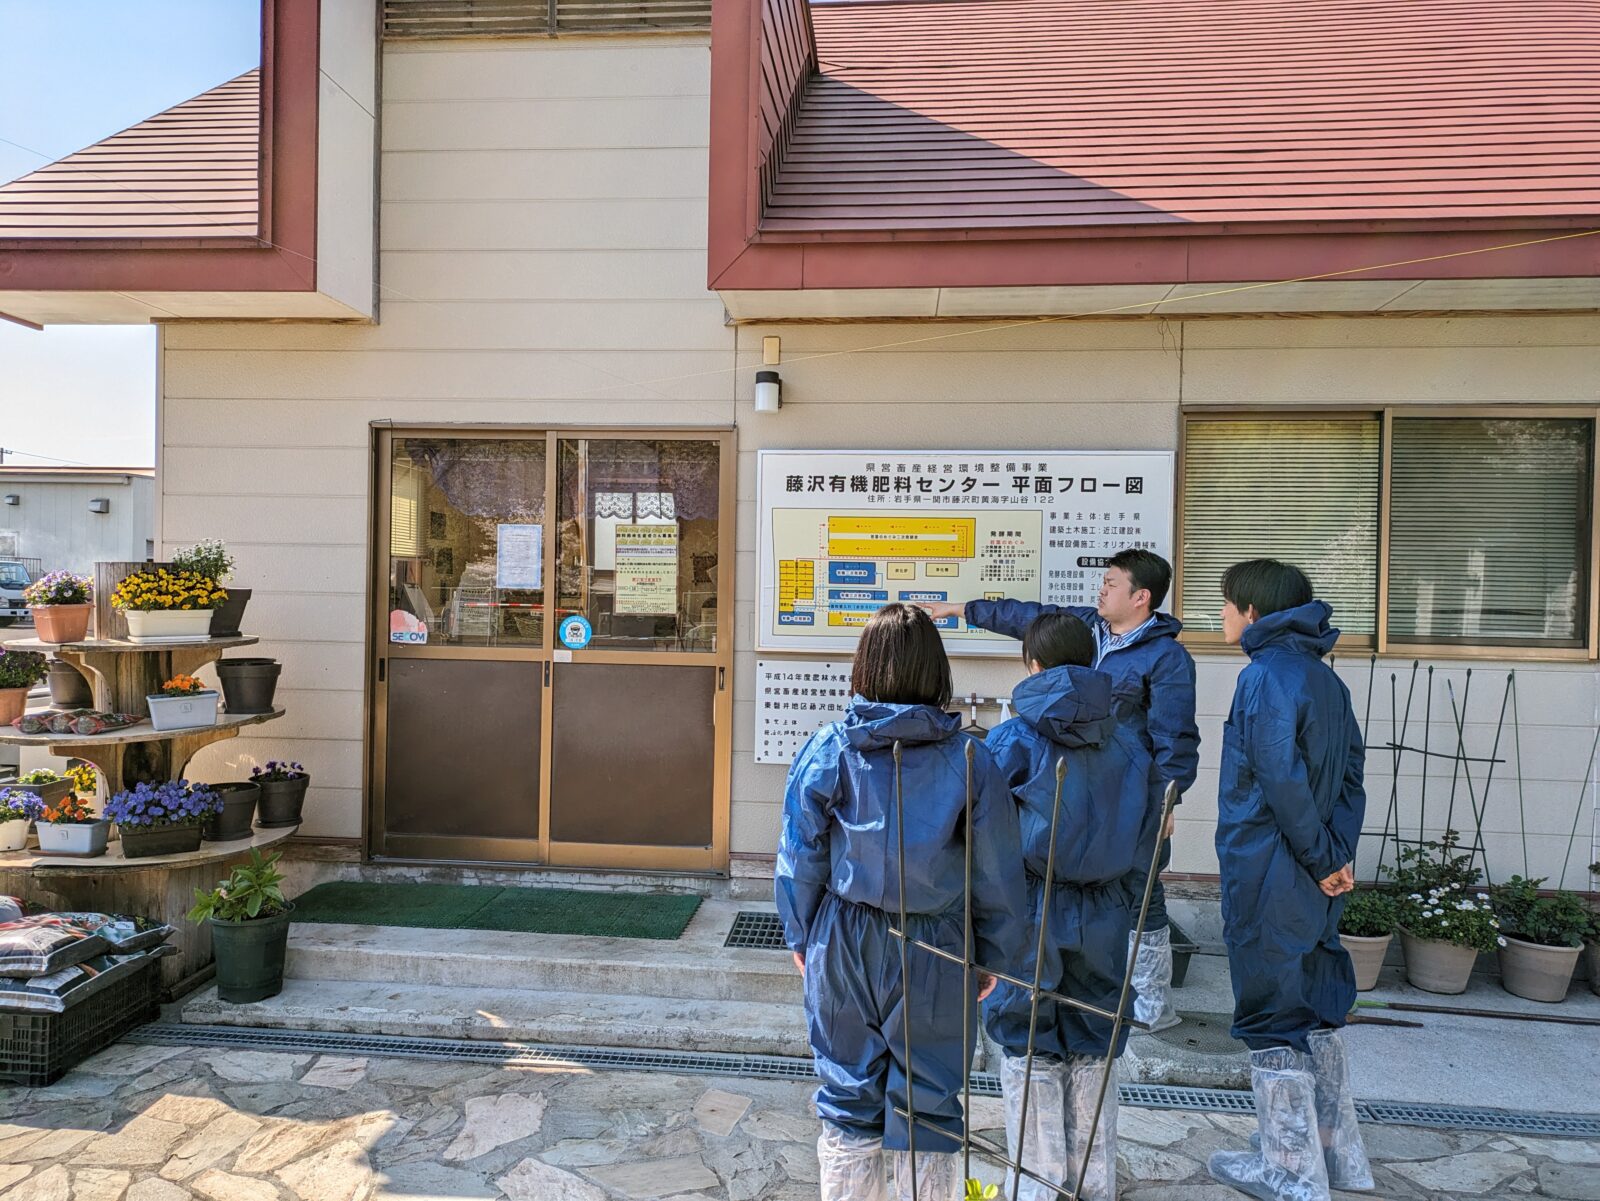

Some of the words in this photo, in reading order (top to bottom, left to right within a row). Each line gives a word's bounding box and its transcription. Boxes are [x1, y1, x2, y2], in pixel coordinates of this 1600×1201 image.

[866, 463, 1048, 474] 県営畜産経営環境整備事業
[785, 475, 1001, 494] 藤沢有機肥料センター
[1011, 475, 1144, 495] 平面フロー図
[392, 632, 425, 641] SECOM
